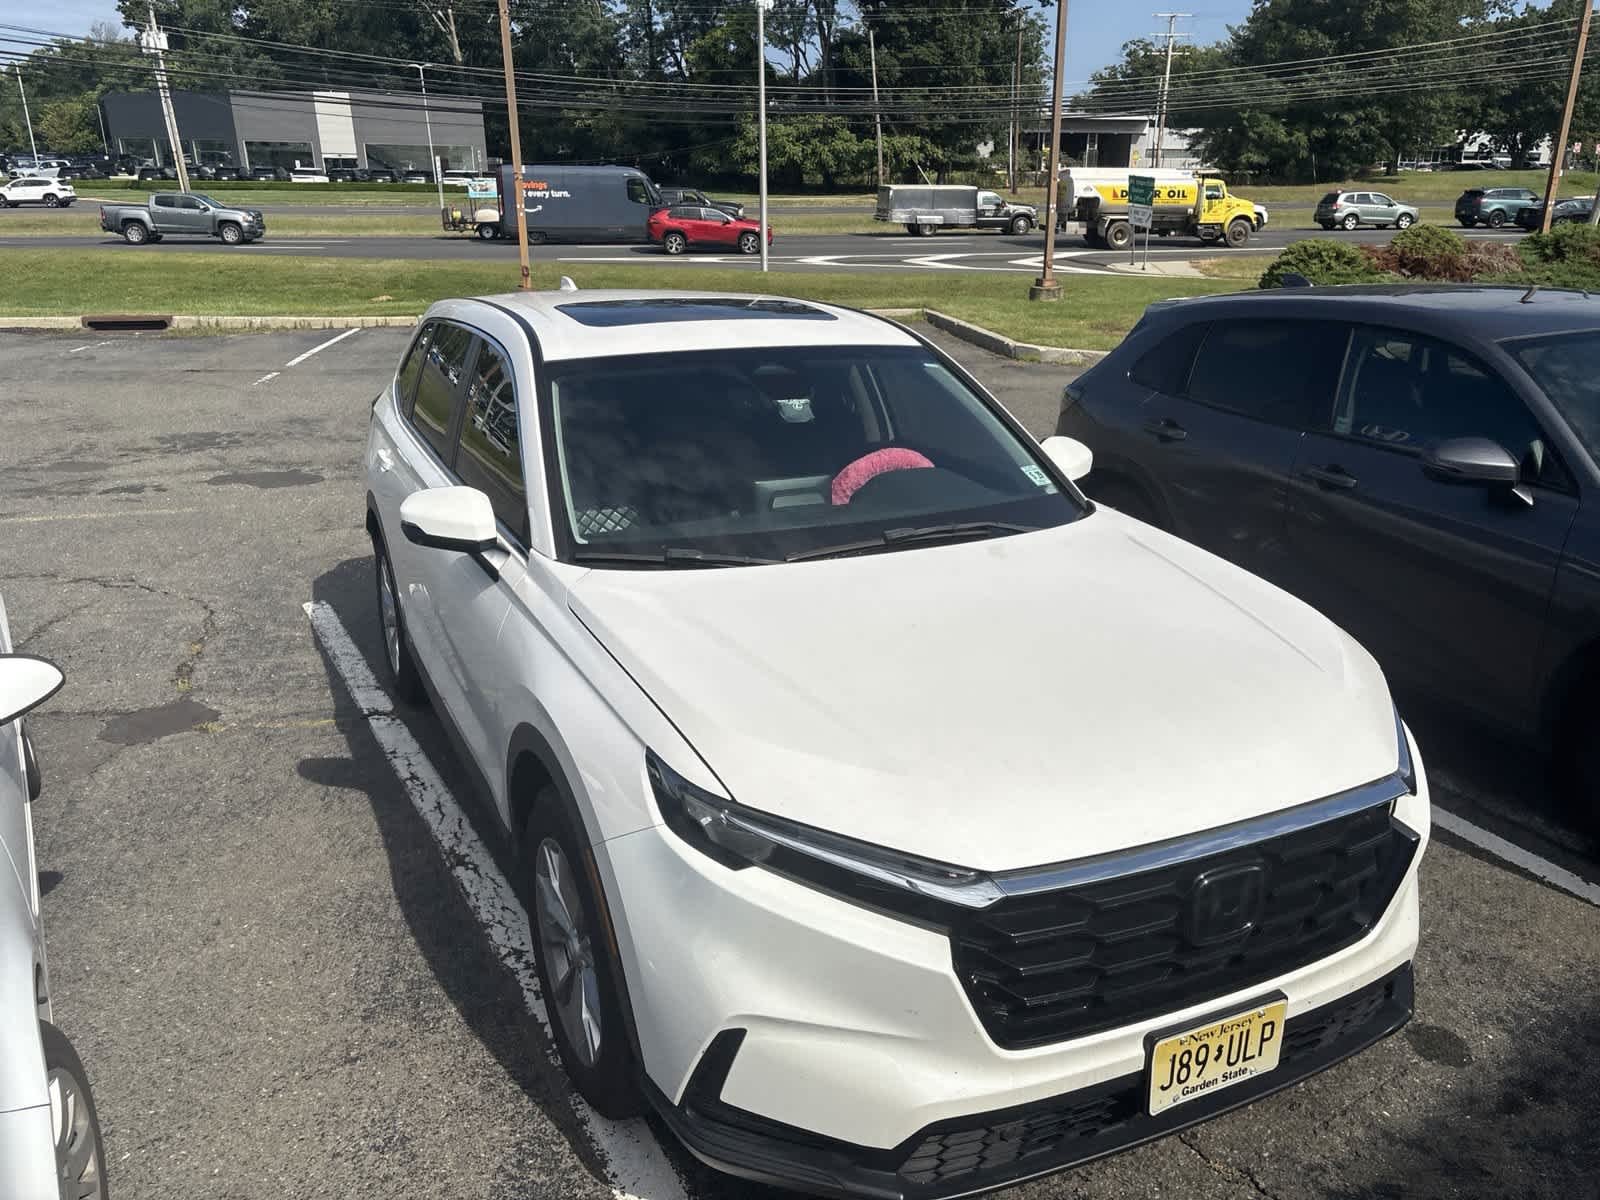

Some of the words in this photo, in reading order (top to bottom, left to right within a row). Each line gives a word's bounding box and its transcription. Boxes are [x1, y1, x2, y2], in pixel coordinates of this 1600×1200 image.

[522, 181, 547, 190] avings
[527, 190, 549, 199] every
[551, 189, 571, 198] turn.
[1167, 189, 1188, 199] OIL
[1188, 1029, 1218, 1046] New
[1217, 1016, 1256, 1038] Jersey
[1181, 1078, 1218, 1096] Garden
[1221, 1066, 1248, 1082] State
